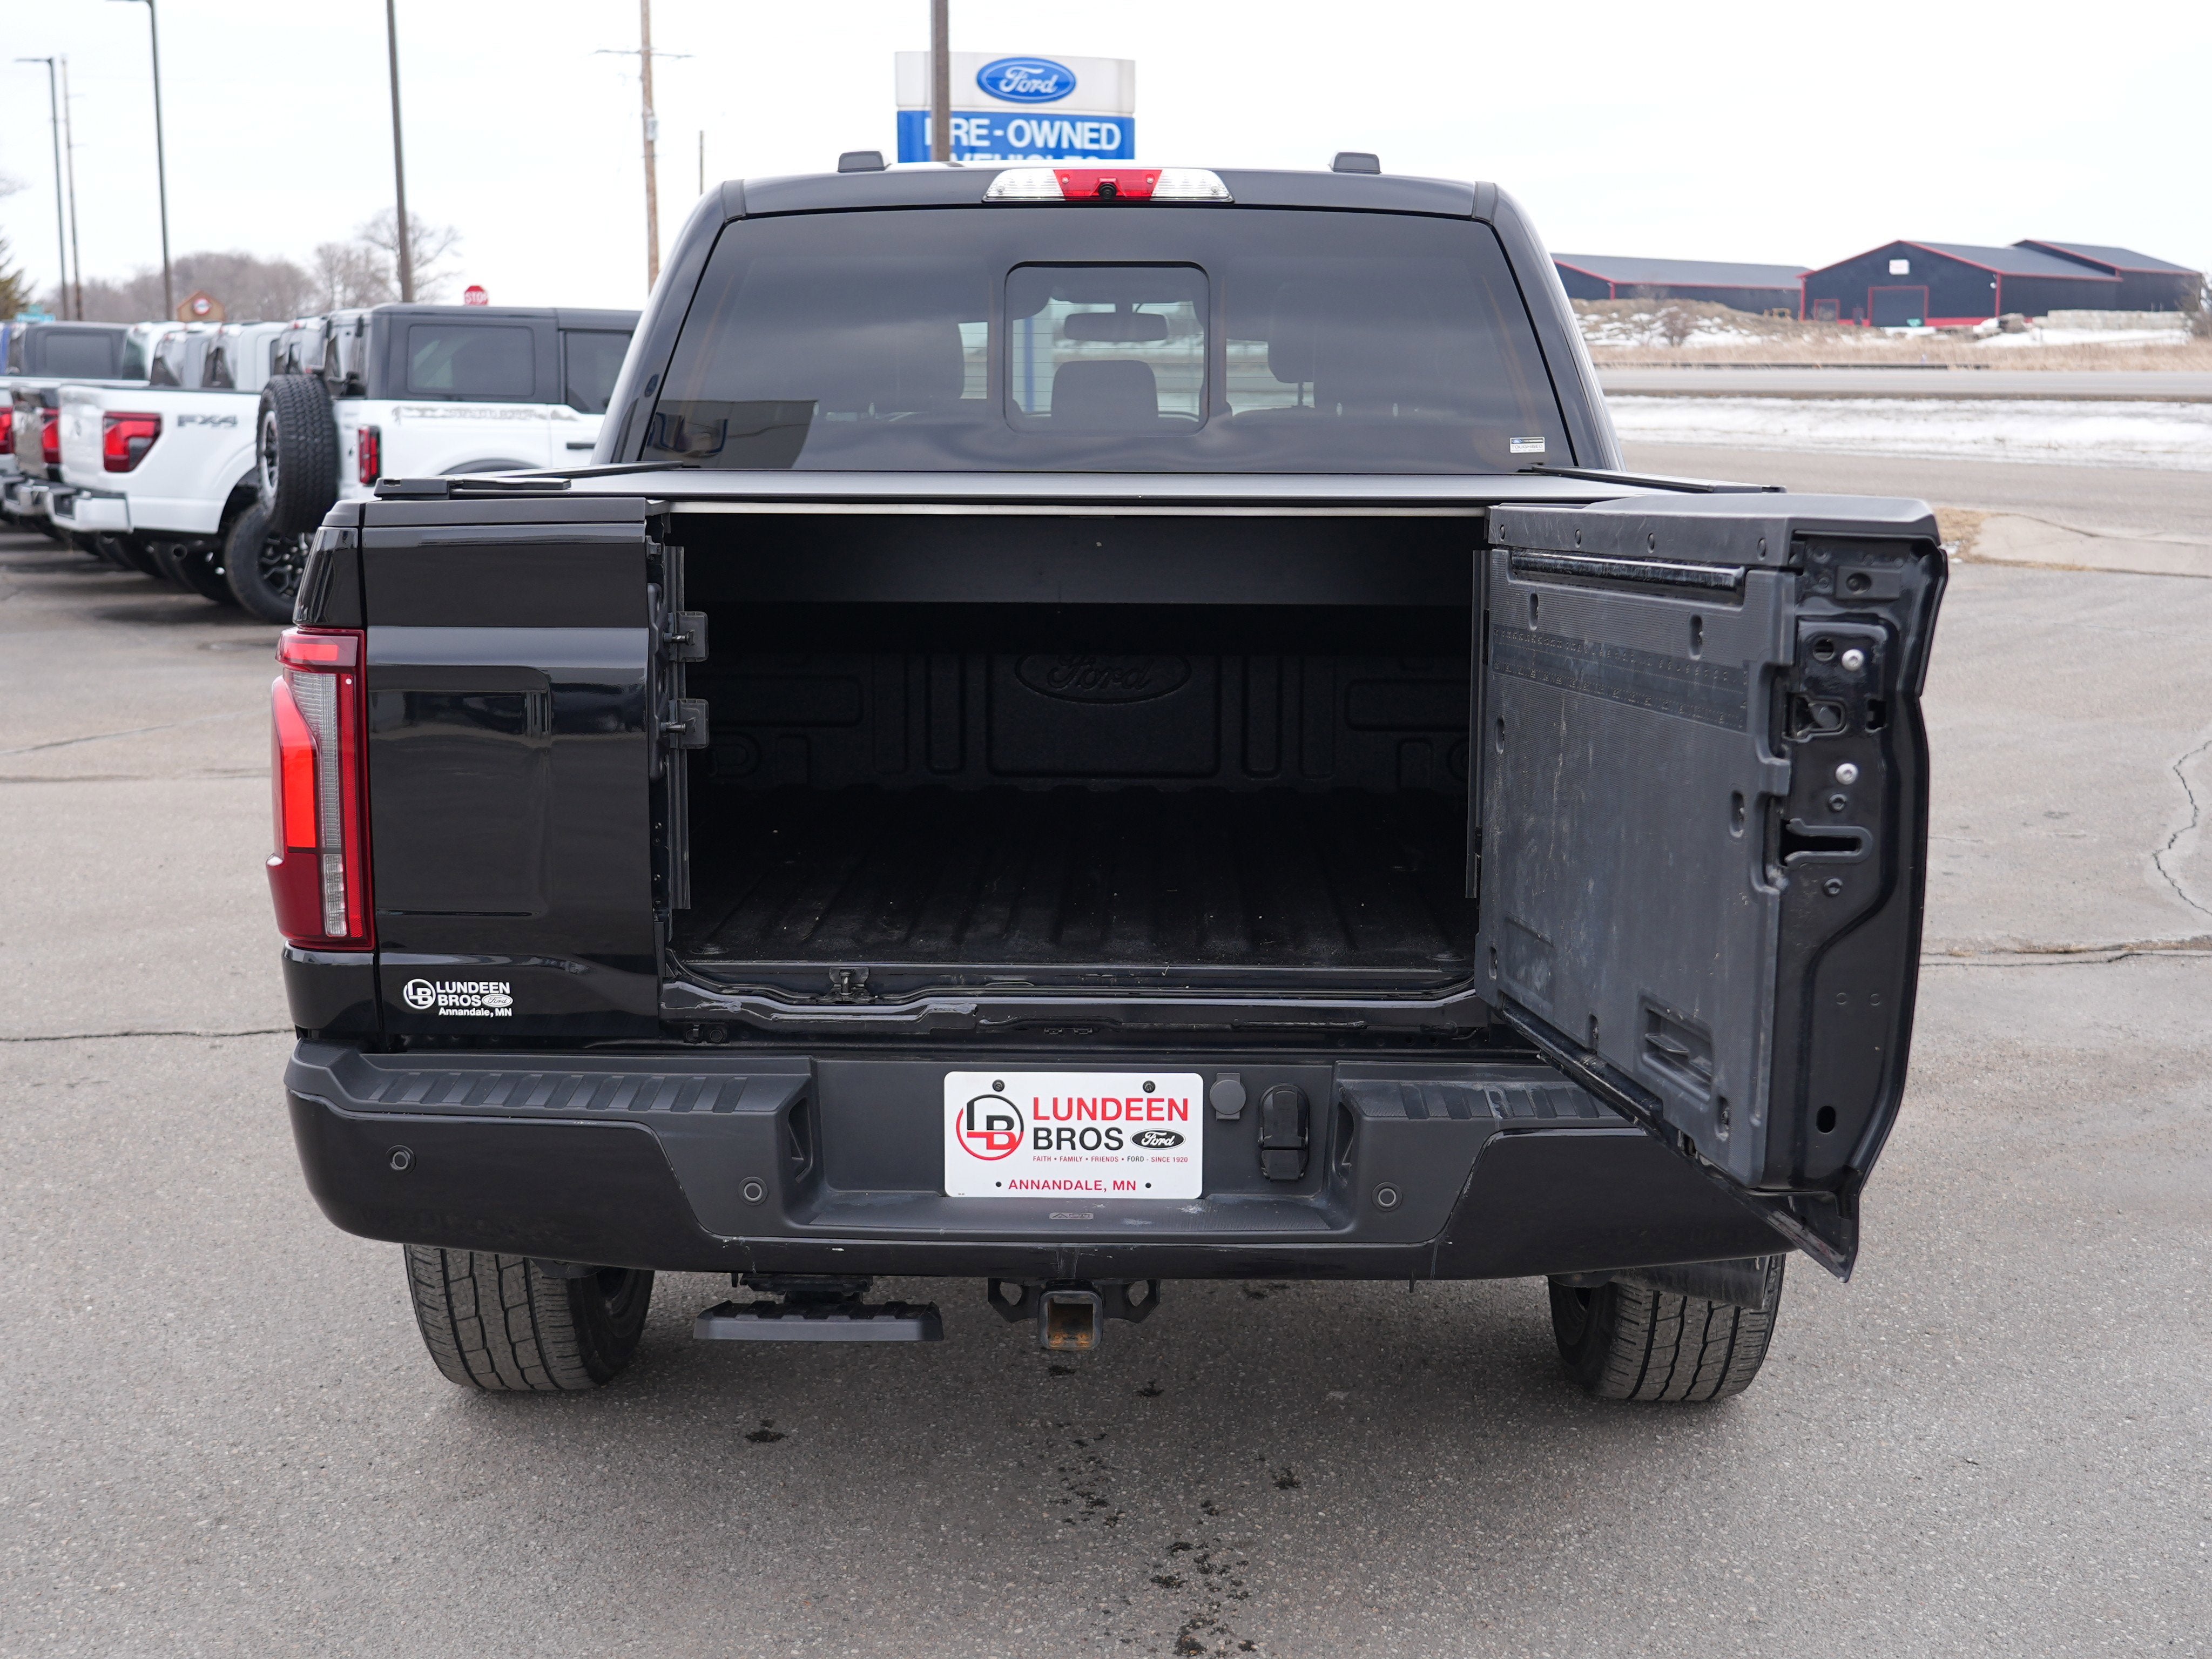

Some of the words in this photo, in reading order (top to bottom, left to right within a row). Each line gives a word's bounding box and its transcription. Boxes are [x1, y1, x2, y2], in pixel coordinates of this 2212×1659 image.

[999, 65, 1059, 94] Ford
[177, 414, 238, 428] FX4
[436, 981, 510, 994] LUNDEEN
[437, 994, 482, 1007] BROS
[439, 1007, 494, 1017] Annandale,
[495, 1008, 512, 1016] MN
[1033, 1097, 1188, 1121] LUNDEEN
[1033, 1127, 1124, 1151] BROS
[1141, 1131, 1176, 1147] Ford
[1008, 1179, 1107, 1192] ANNANDALE,
[1113, 1180, 1136, 1191] MN
